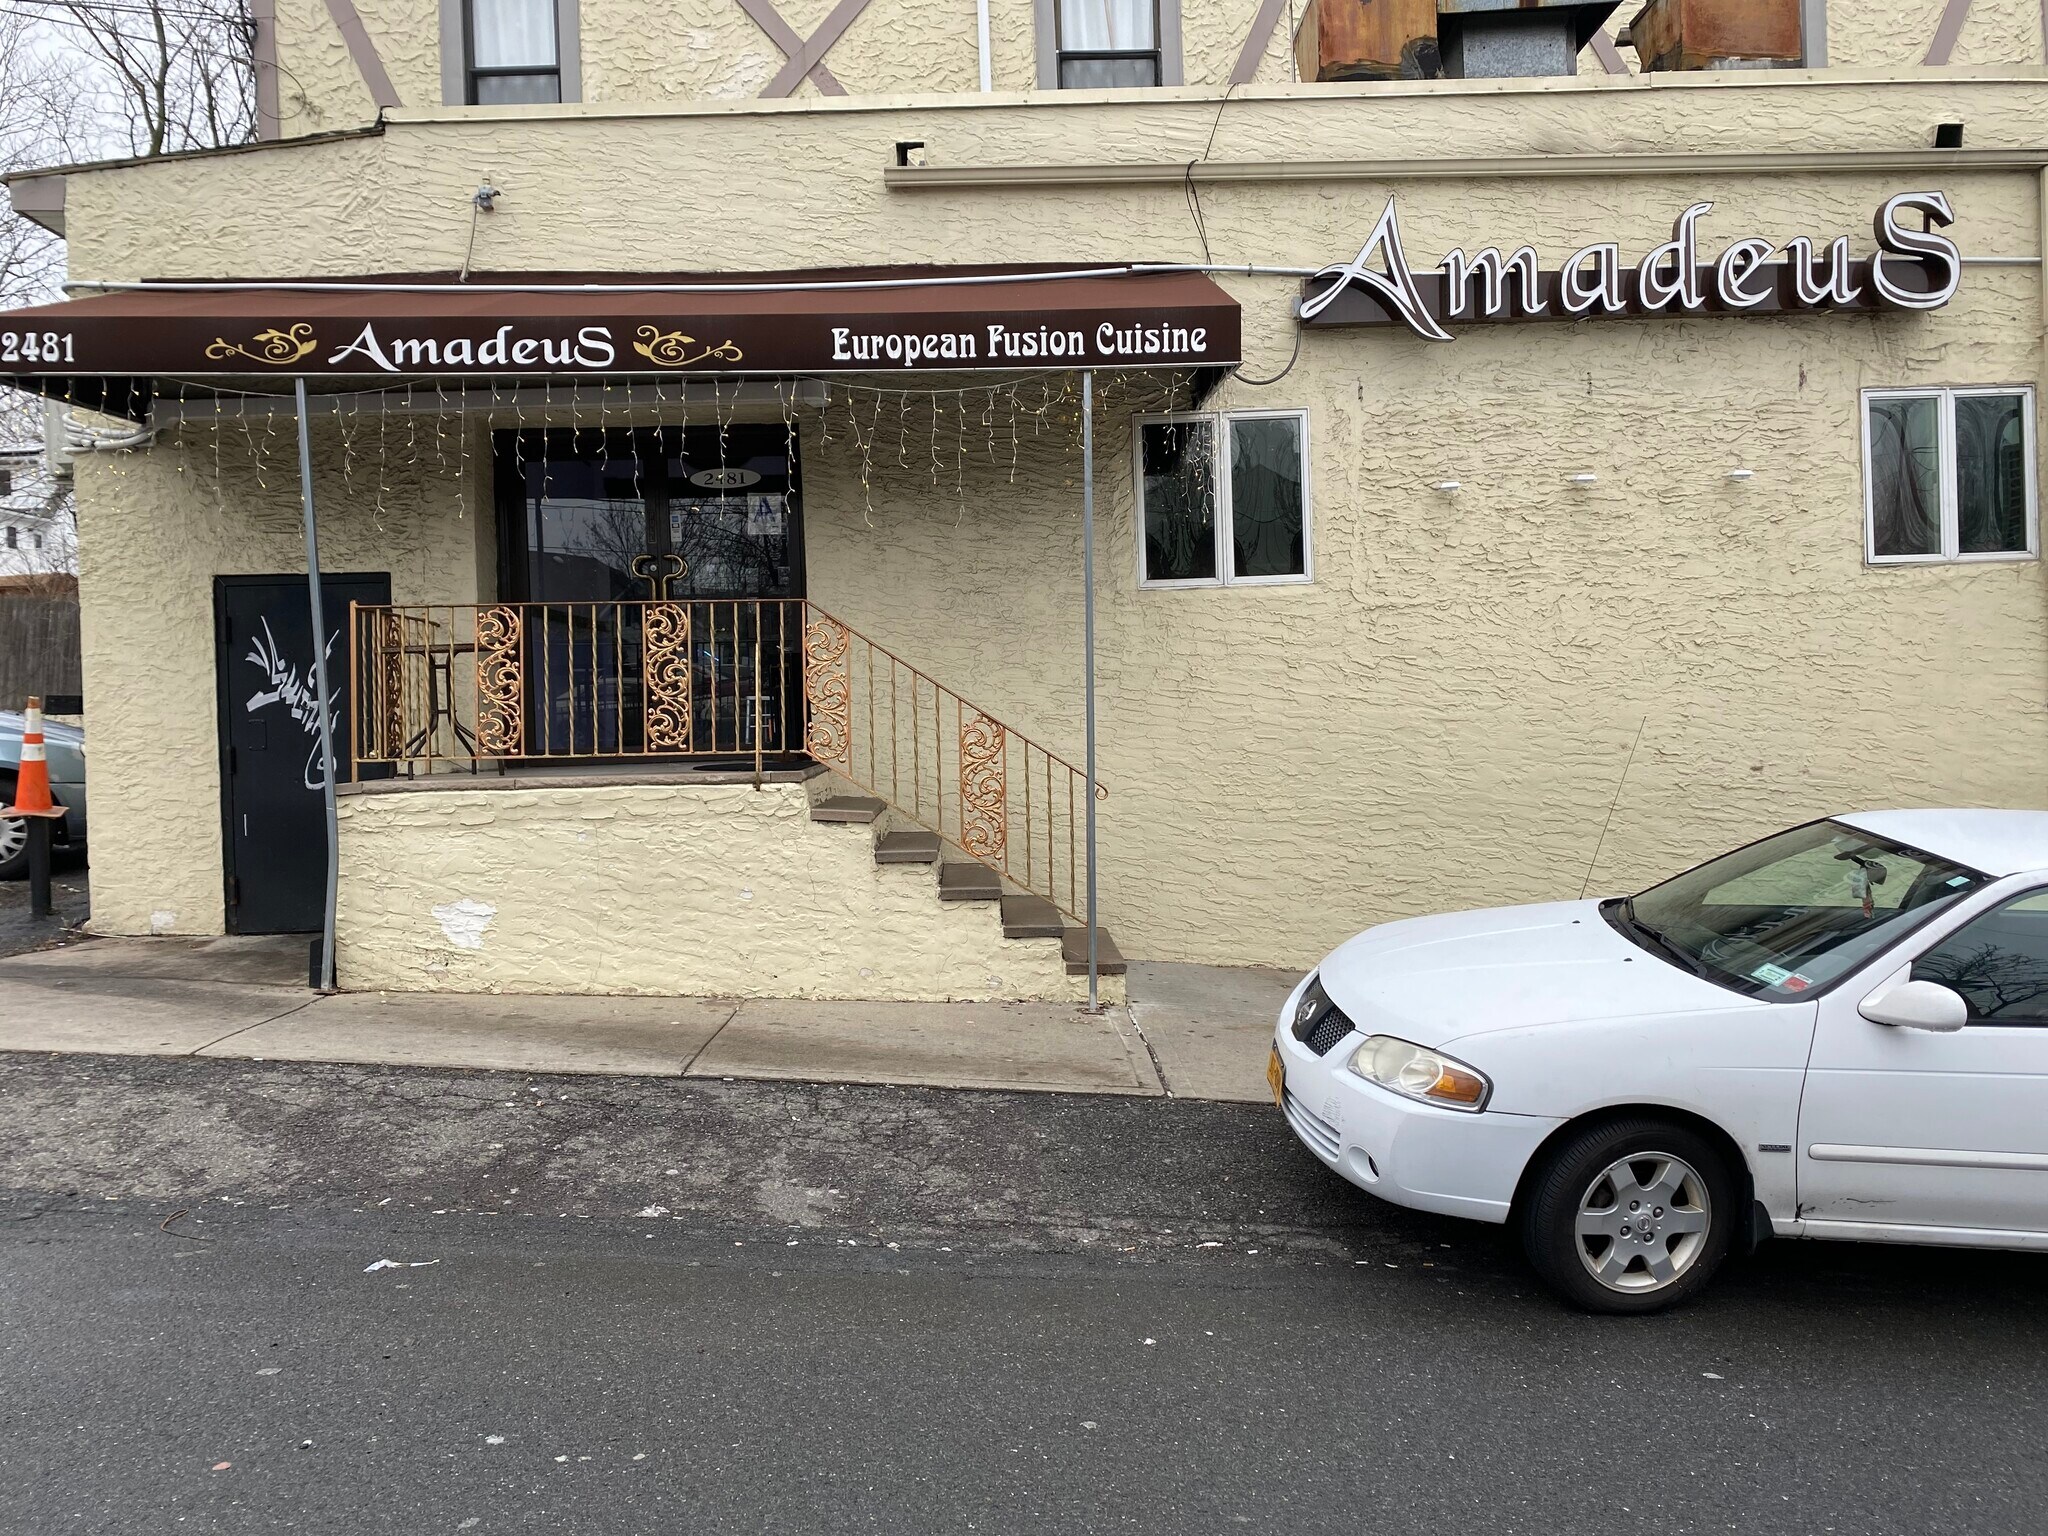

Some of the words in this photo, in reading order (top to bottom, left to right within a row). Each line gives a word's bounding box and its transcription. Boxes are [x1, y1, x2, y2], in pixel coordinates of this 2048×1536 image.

[1300, 190, 1962, 343] AmadeuS
[1, 331, 75, 363] 2481
[327, 321, 616, 372] AmadeuS
[831, 327, 977, 367] European
[987, 324, 1085, 358] Fusion
[1096, 322, 1207, 356] Cuisine
[753, 496, 777, 523] A
